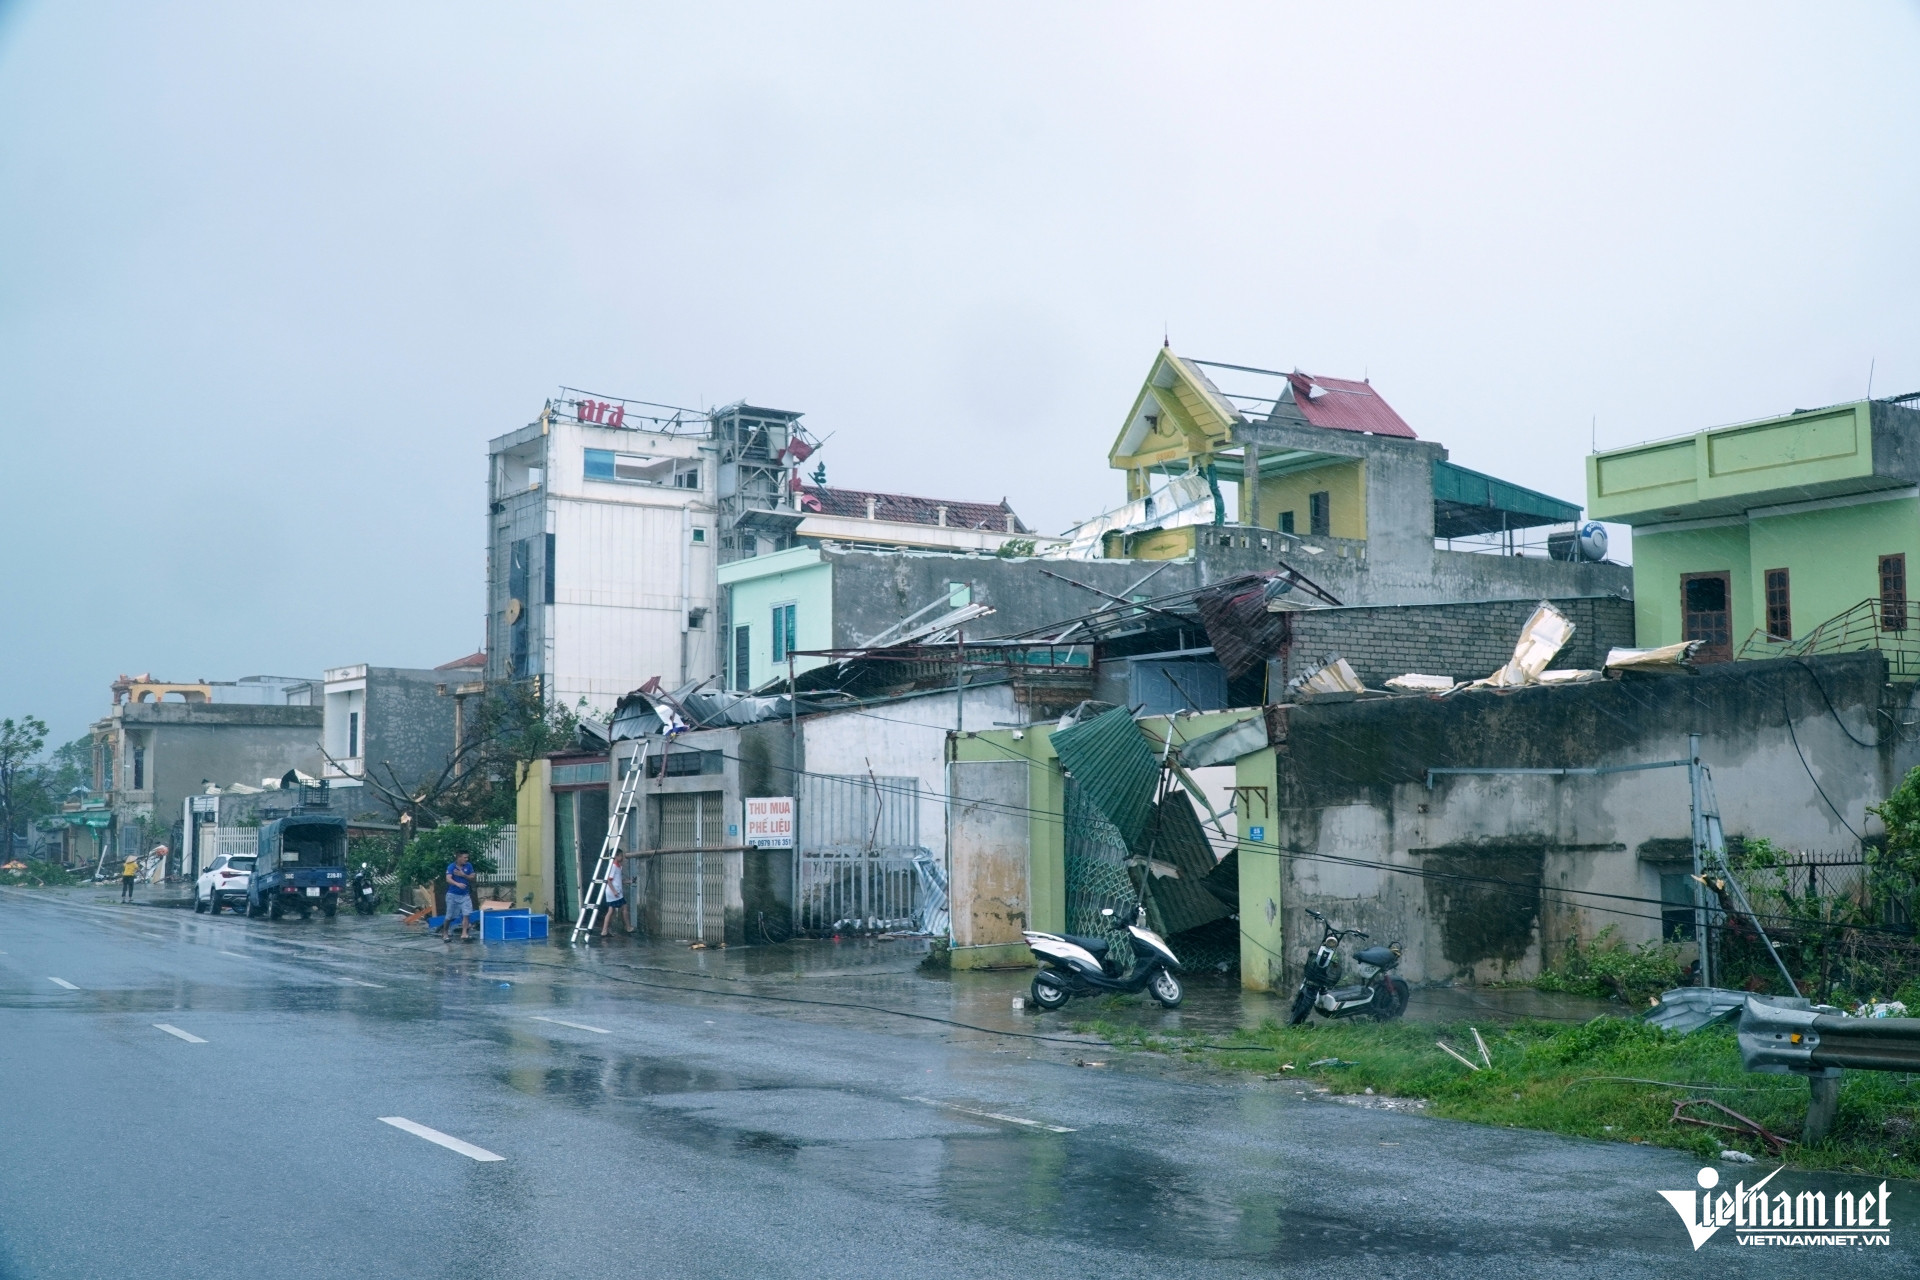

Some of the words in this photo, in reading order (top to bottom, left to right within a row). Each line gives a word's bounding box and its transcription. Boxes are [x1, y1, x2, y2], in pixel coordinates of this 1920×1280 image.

[749, 803, 767, 815] THU
[770, 802, 791, 814] MUA
[749, 817, 768, 833] PHẾ
[770, 818, 790, 835] LIỆU
